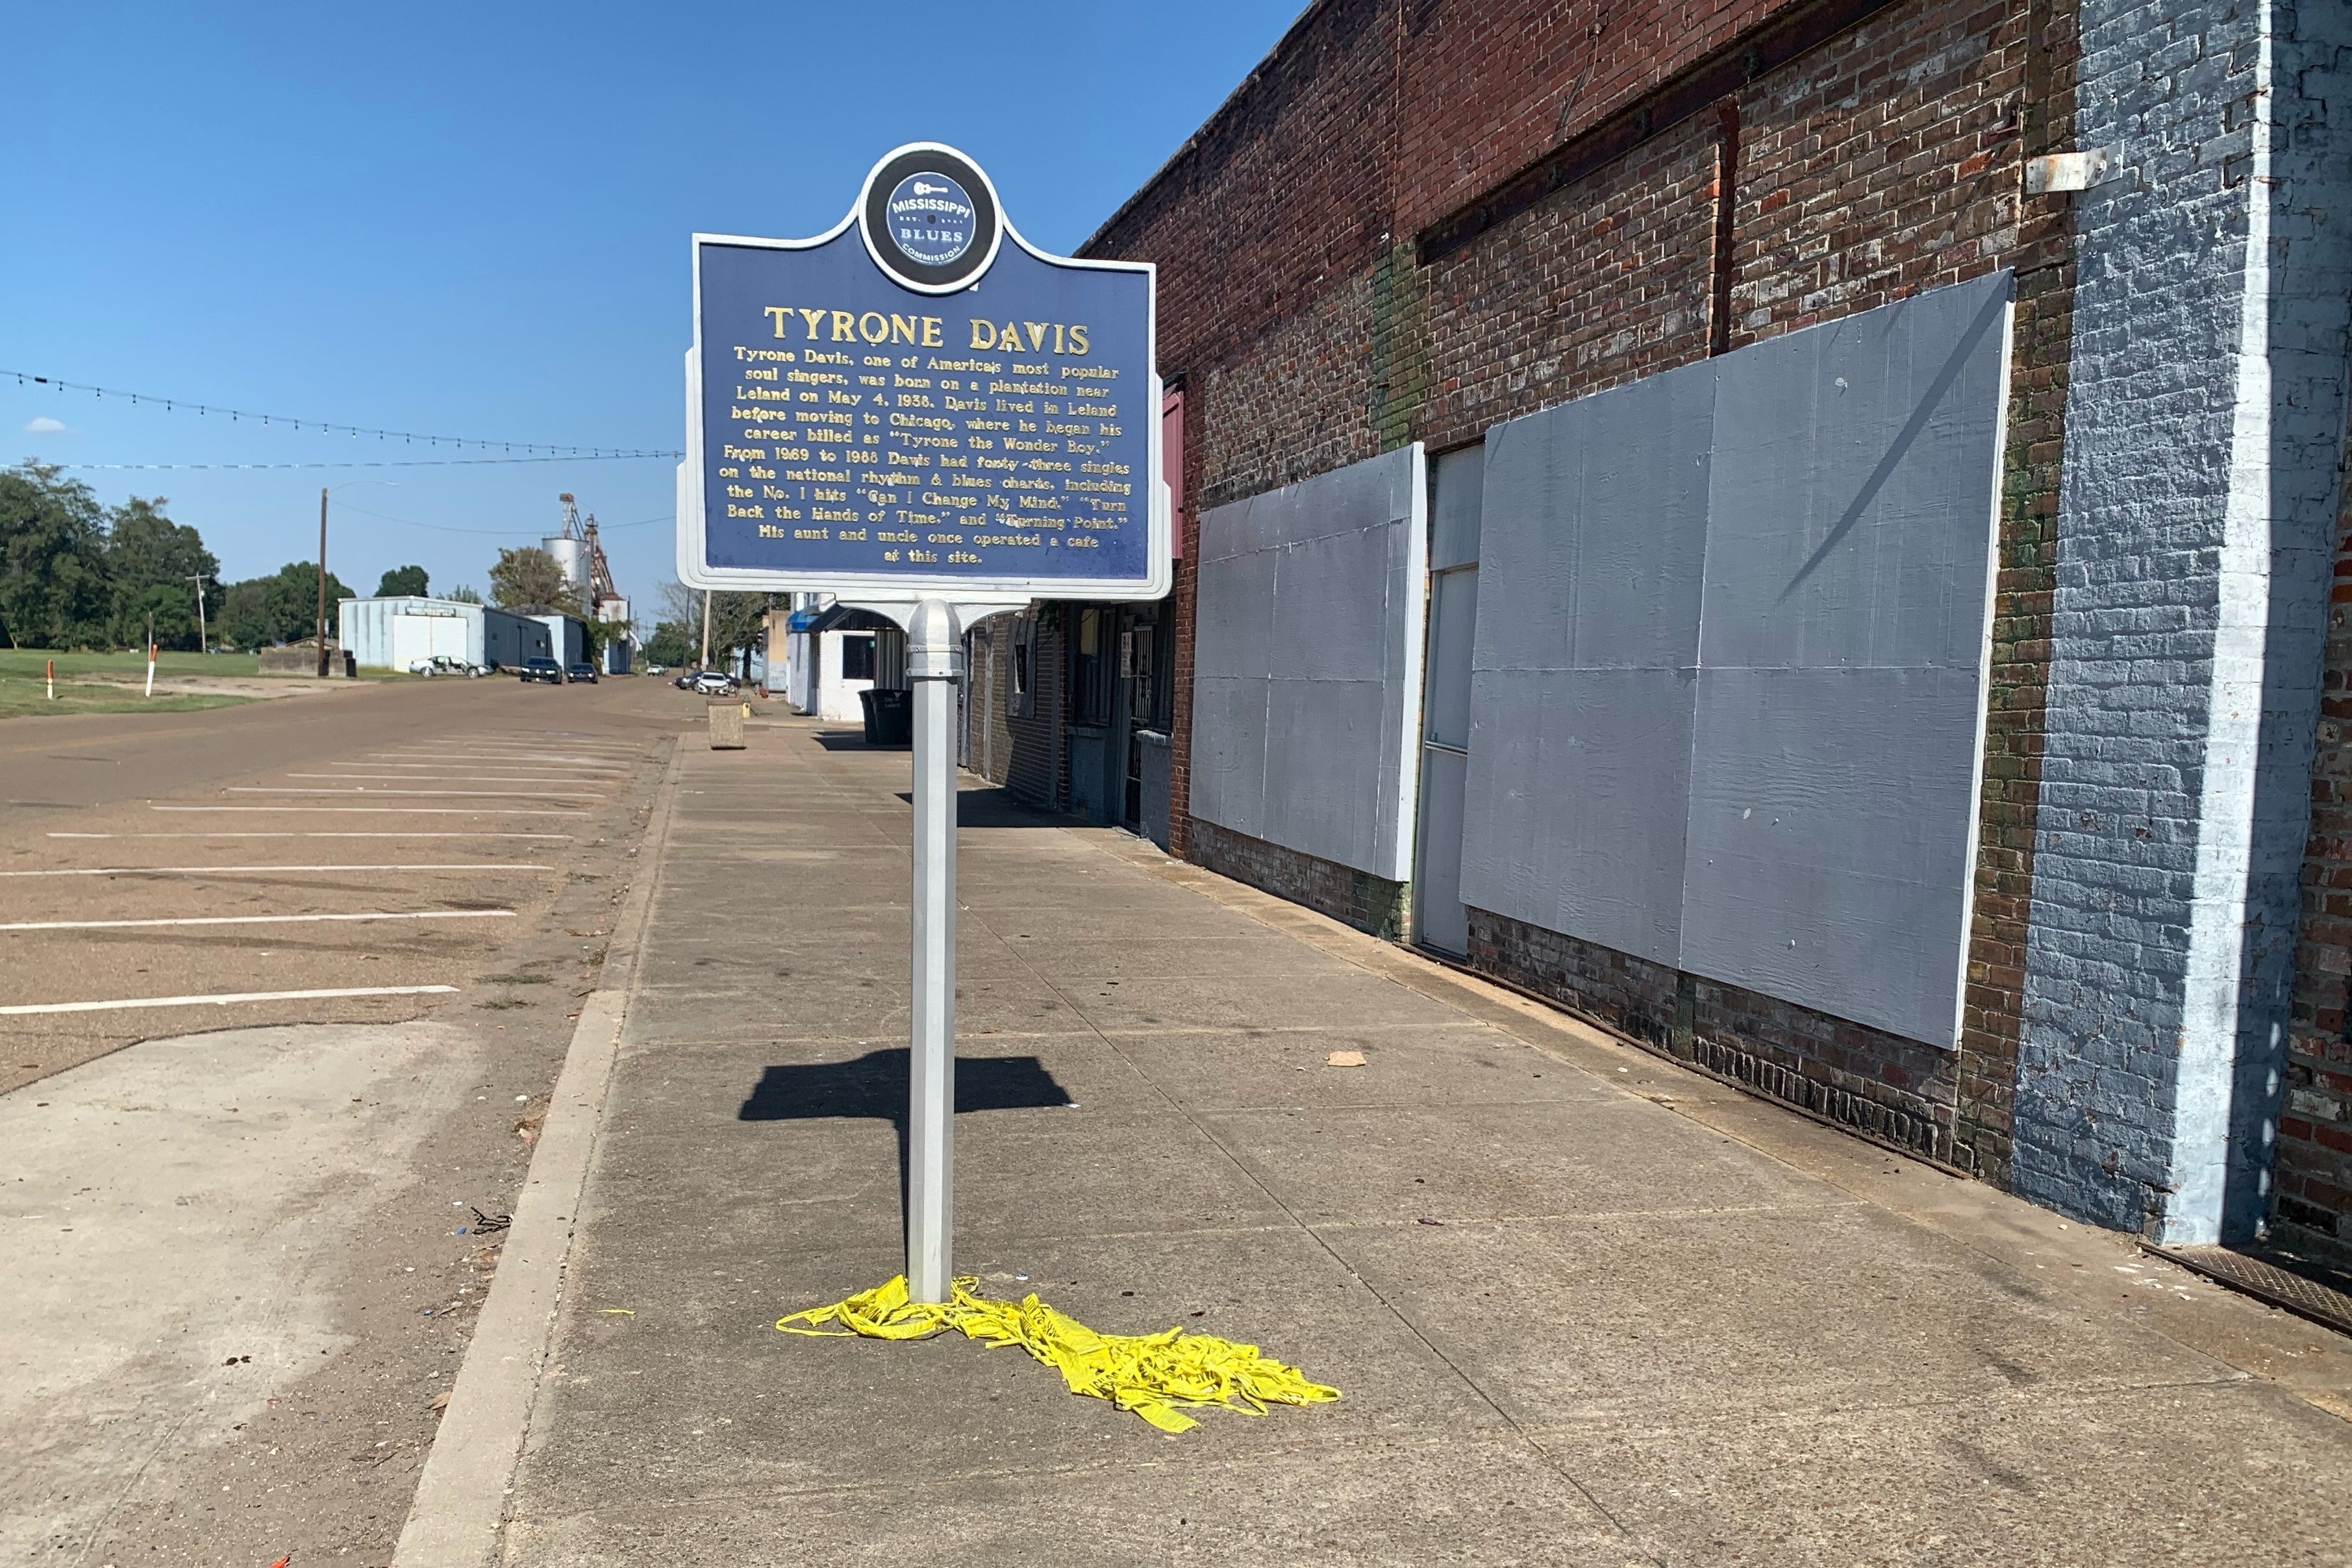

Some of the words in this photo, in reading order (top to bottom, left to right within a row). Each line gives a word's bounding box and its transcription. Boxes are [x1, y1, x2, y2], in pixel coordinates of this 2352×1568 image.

[892, 198, 971, 218] MISSISSIPPI
[900, 227, 963, 243] BLUES
[902, 243, 961, 261] COMMISSION
[764, 306, 944, 347] TYRONE
[969, 319, 1090, 355] DAVIS
[733, 345, 795, 362] Tyrone
[804, 349, 855, 366] Davis,
[863, 356, 892, 367] one
[901, 356, 919, 368] of
[1012, 362, 1049, 375] most
[1060, 366, 1120, 380] popular
[745, 367, 778, 381] soul
[786, 368, 849, 386] singers,
[858, 375, 886, 386] was
[894, 373, 931, 389] born
[940, 379, 960, 390] on
[970, 381, 979, 391] a
[989, 379, 1068, 395] plantation
[1076, 386, 1110, 397] near
[736, 386, 790, 401] Leland
[799, 392, 819, 403] on
[828, 390, 862, 406] May
[872, 393, 889, 407] 4,
[897, 394, 935, 408] 1938.
[945, 395, 986, 412] Davis
[995, 399, 1034, 414] lived
[1044, 401, 1058, 414] in
[1068, 402, 1117, 417] Leland
[731, 405, 786, 423] before
[795, 410, 853, 427] moving
[862, 412, 880, 425] to
[889, 412, 956, 431] Chicago,
[965, 417, 1010, 431] where
[1019, 419, 1037, 432] he
[1045, 420, 1090, 437] began
[1099, 423, 1122, 436] his
[744, 429, 797, 441] career
[807, 428, 853, 443] billed
[863, 434, 880, 444] as
[968, 436, 994, 449] the
[1003, 437, 1058, 452] Wonder
[723, 444, 766, 462] From
[775, 447, 810, 461] 1969
[819, 449, 836, 462] to
[845, 450, 879, 464] 1988
[888, 451, 931, 467] Davis
[940, 454, 968, 468] had
[1081, 460, 1130, 477] singles
[719, 467, 739, 479] on
[749, 466, 776, 479] the
[786, 468, 851, 482] national
[861, 471, 921, 486] rhythm
[930, 473, 942, 486] &
[951, 473, 992, 488] blues
[1001, 476, 1055, 491] charts,
[1064, 479, 1132, 496] including
[726, 484, 754, 498] the
[763, 485, 790, 501] No.
[814, 488, 846, 503] hits
[907, 491, 912, 504] I
[921, 492, 977, 509] Change
[986, 494, 1010, 511] My
[727, 504, 765, 519] Back
[775, 506, 801, 519] the
[812, 507, 859, 521] Hands
[868, 510, 886, 522] of
[959, 513, 987, 525] and
[758, 525, 784, 538] His
[794, 527, 829, 540] aunt
[839, 528, 868, 541] and
[877, 529, 918, 543] uncle
[927, 533, 963, 544] once
[973, 533, 1040, 547] operated
[1050, 538, 1058, 547] a
[1067, 536, 1099, 548] cafe
[884, 549, 900, 562] at
[908, 549, 938, 563] this
[947, 551, 982, 564] site.
